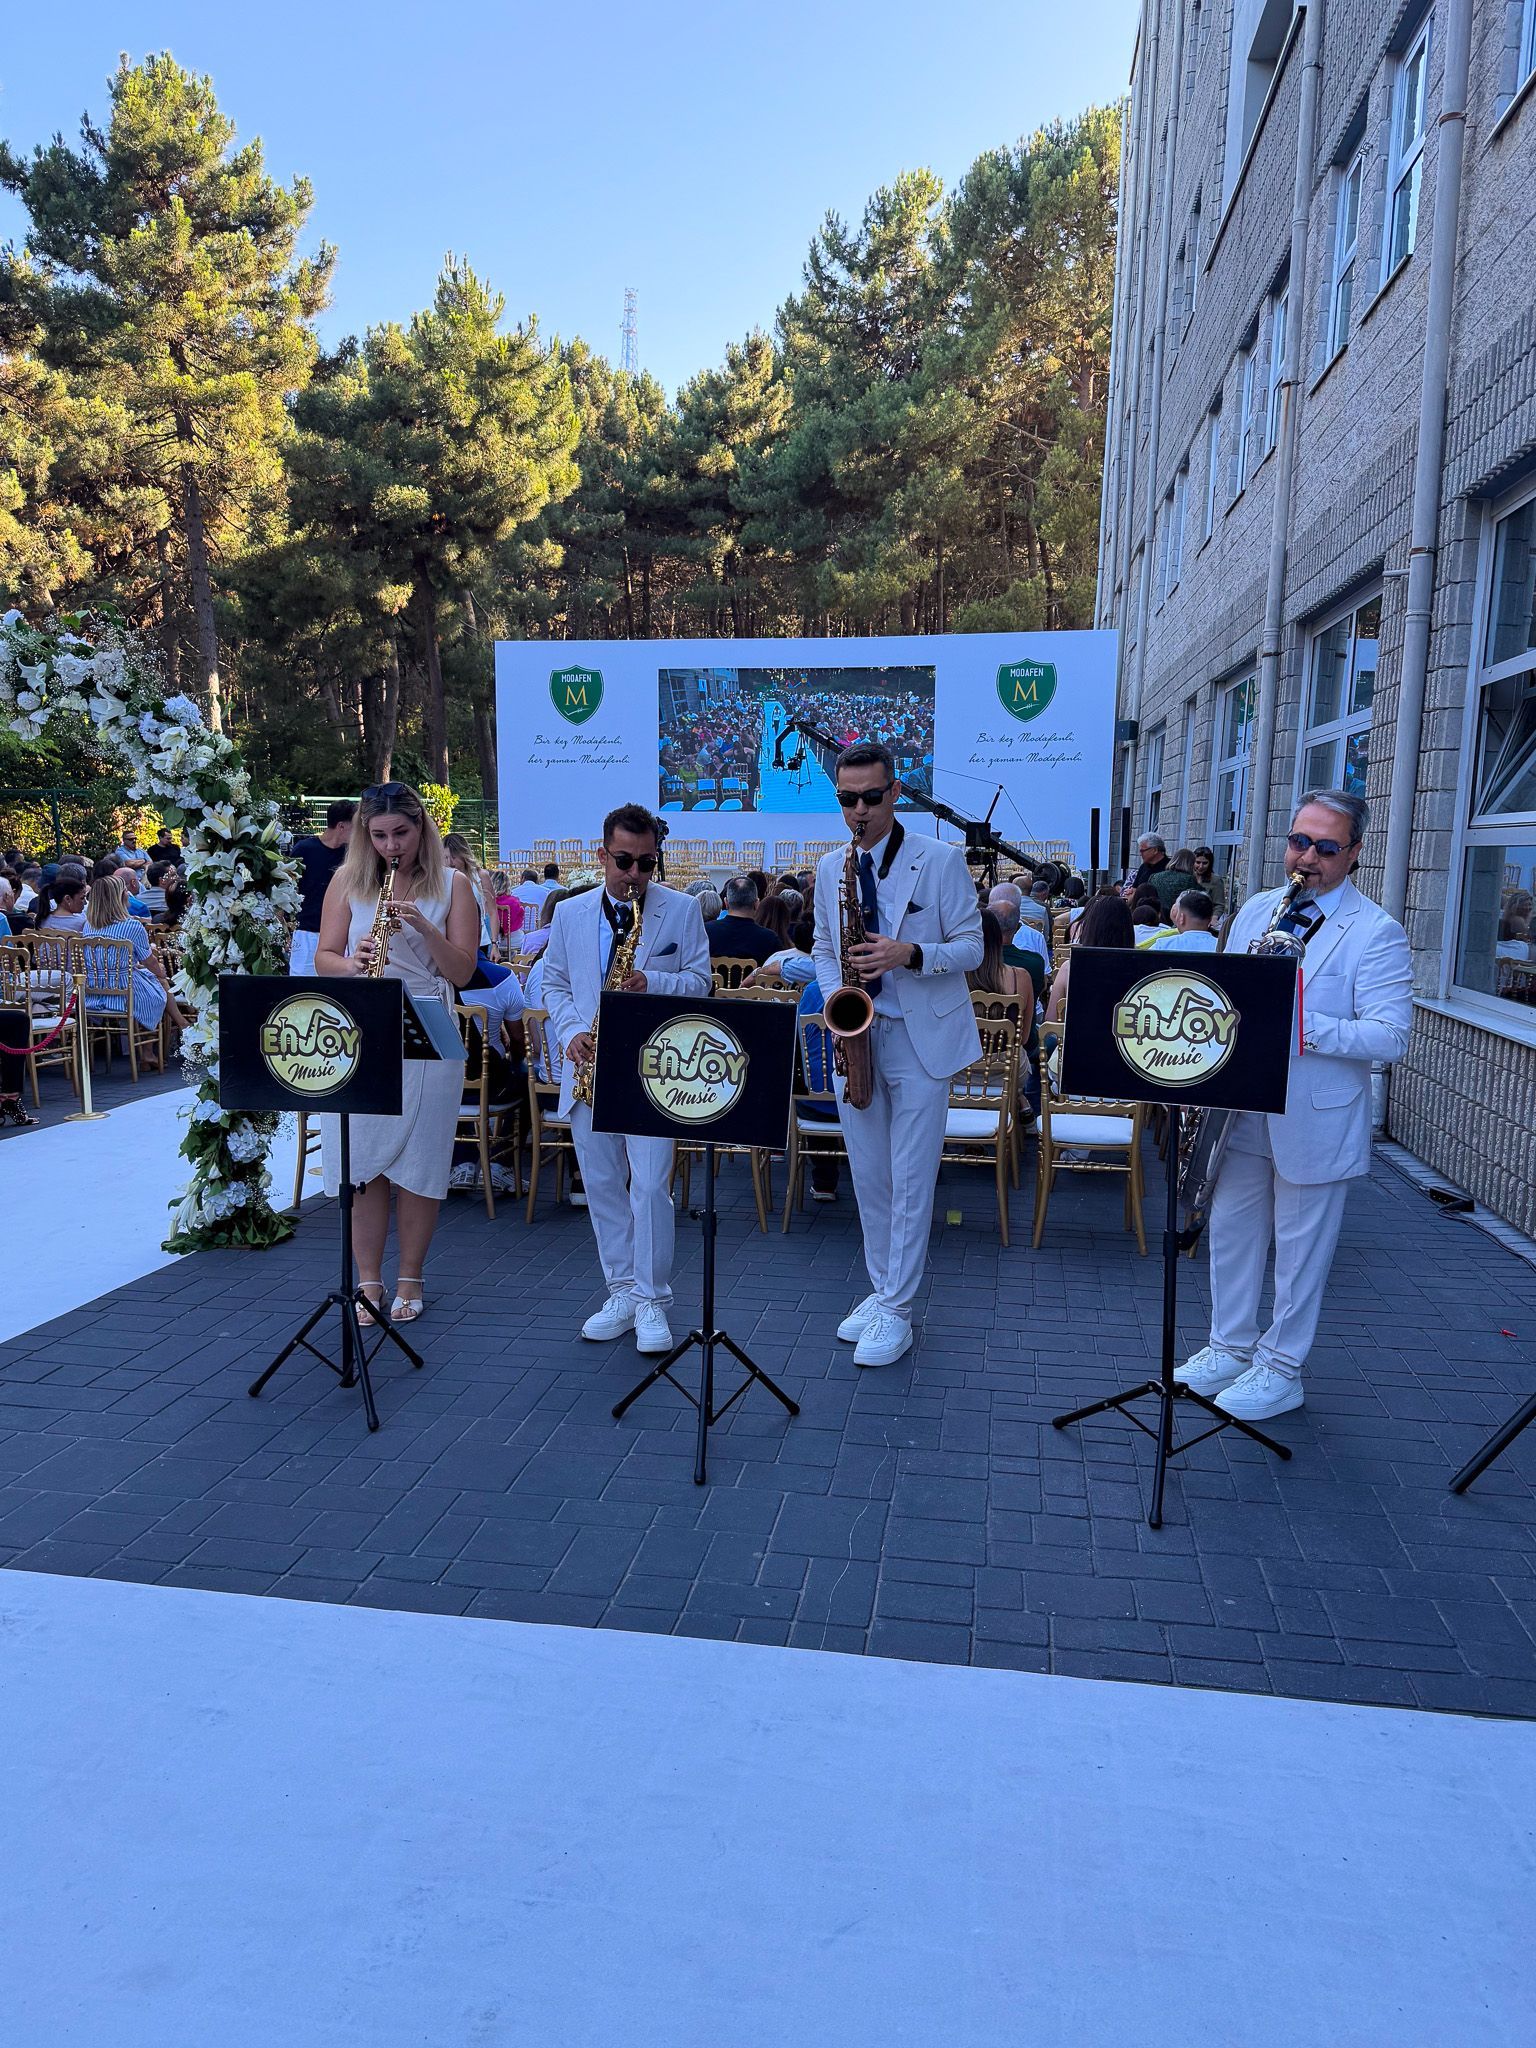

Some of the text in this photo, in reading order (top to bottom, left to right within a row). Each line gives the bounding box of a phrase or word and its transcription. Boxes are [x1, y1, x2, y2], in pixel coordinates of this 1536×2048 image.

[1010, 668, 1044, 677] MODAFEN
[561, 674, 592, 683] MODAFEN
[565, 685, 590, 706] M
[1012, 680, 1040, 702] M
[534, 734, 551, 745] Bir
[976, 732, 995, 743] Bir
[527, 753, 543, 764] her
[968, 753, 986, 763] her
[1142, 1047, 1204, 1070] Music
[287, 1061, 337, 1083] Music
[665, 1087, 718, 1109] Music
